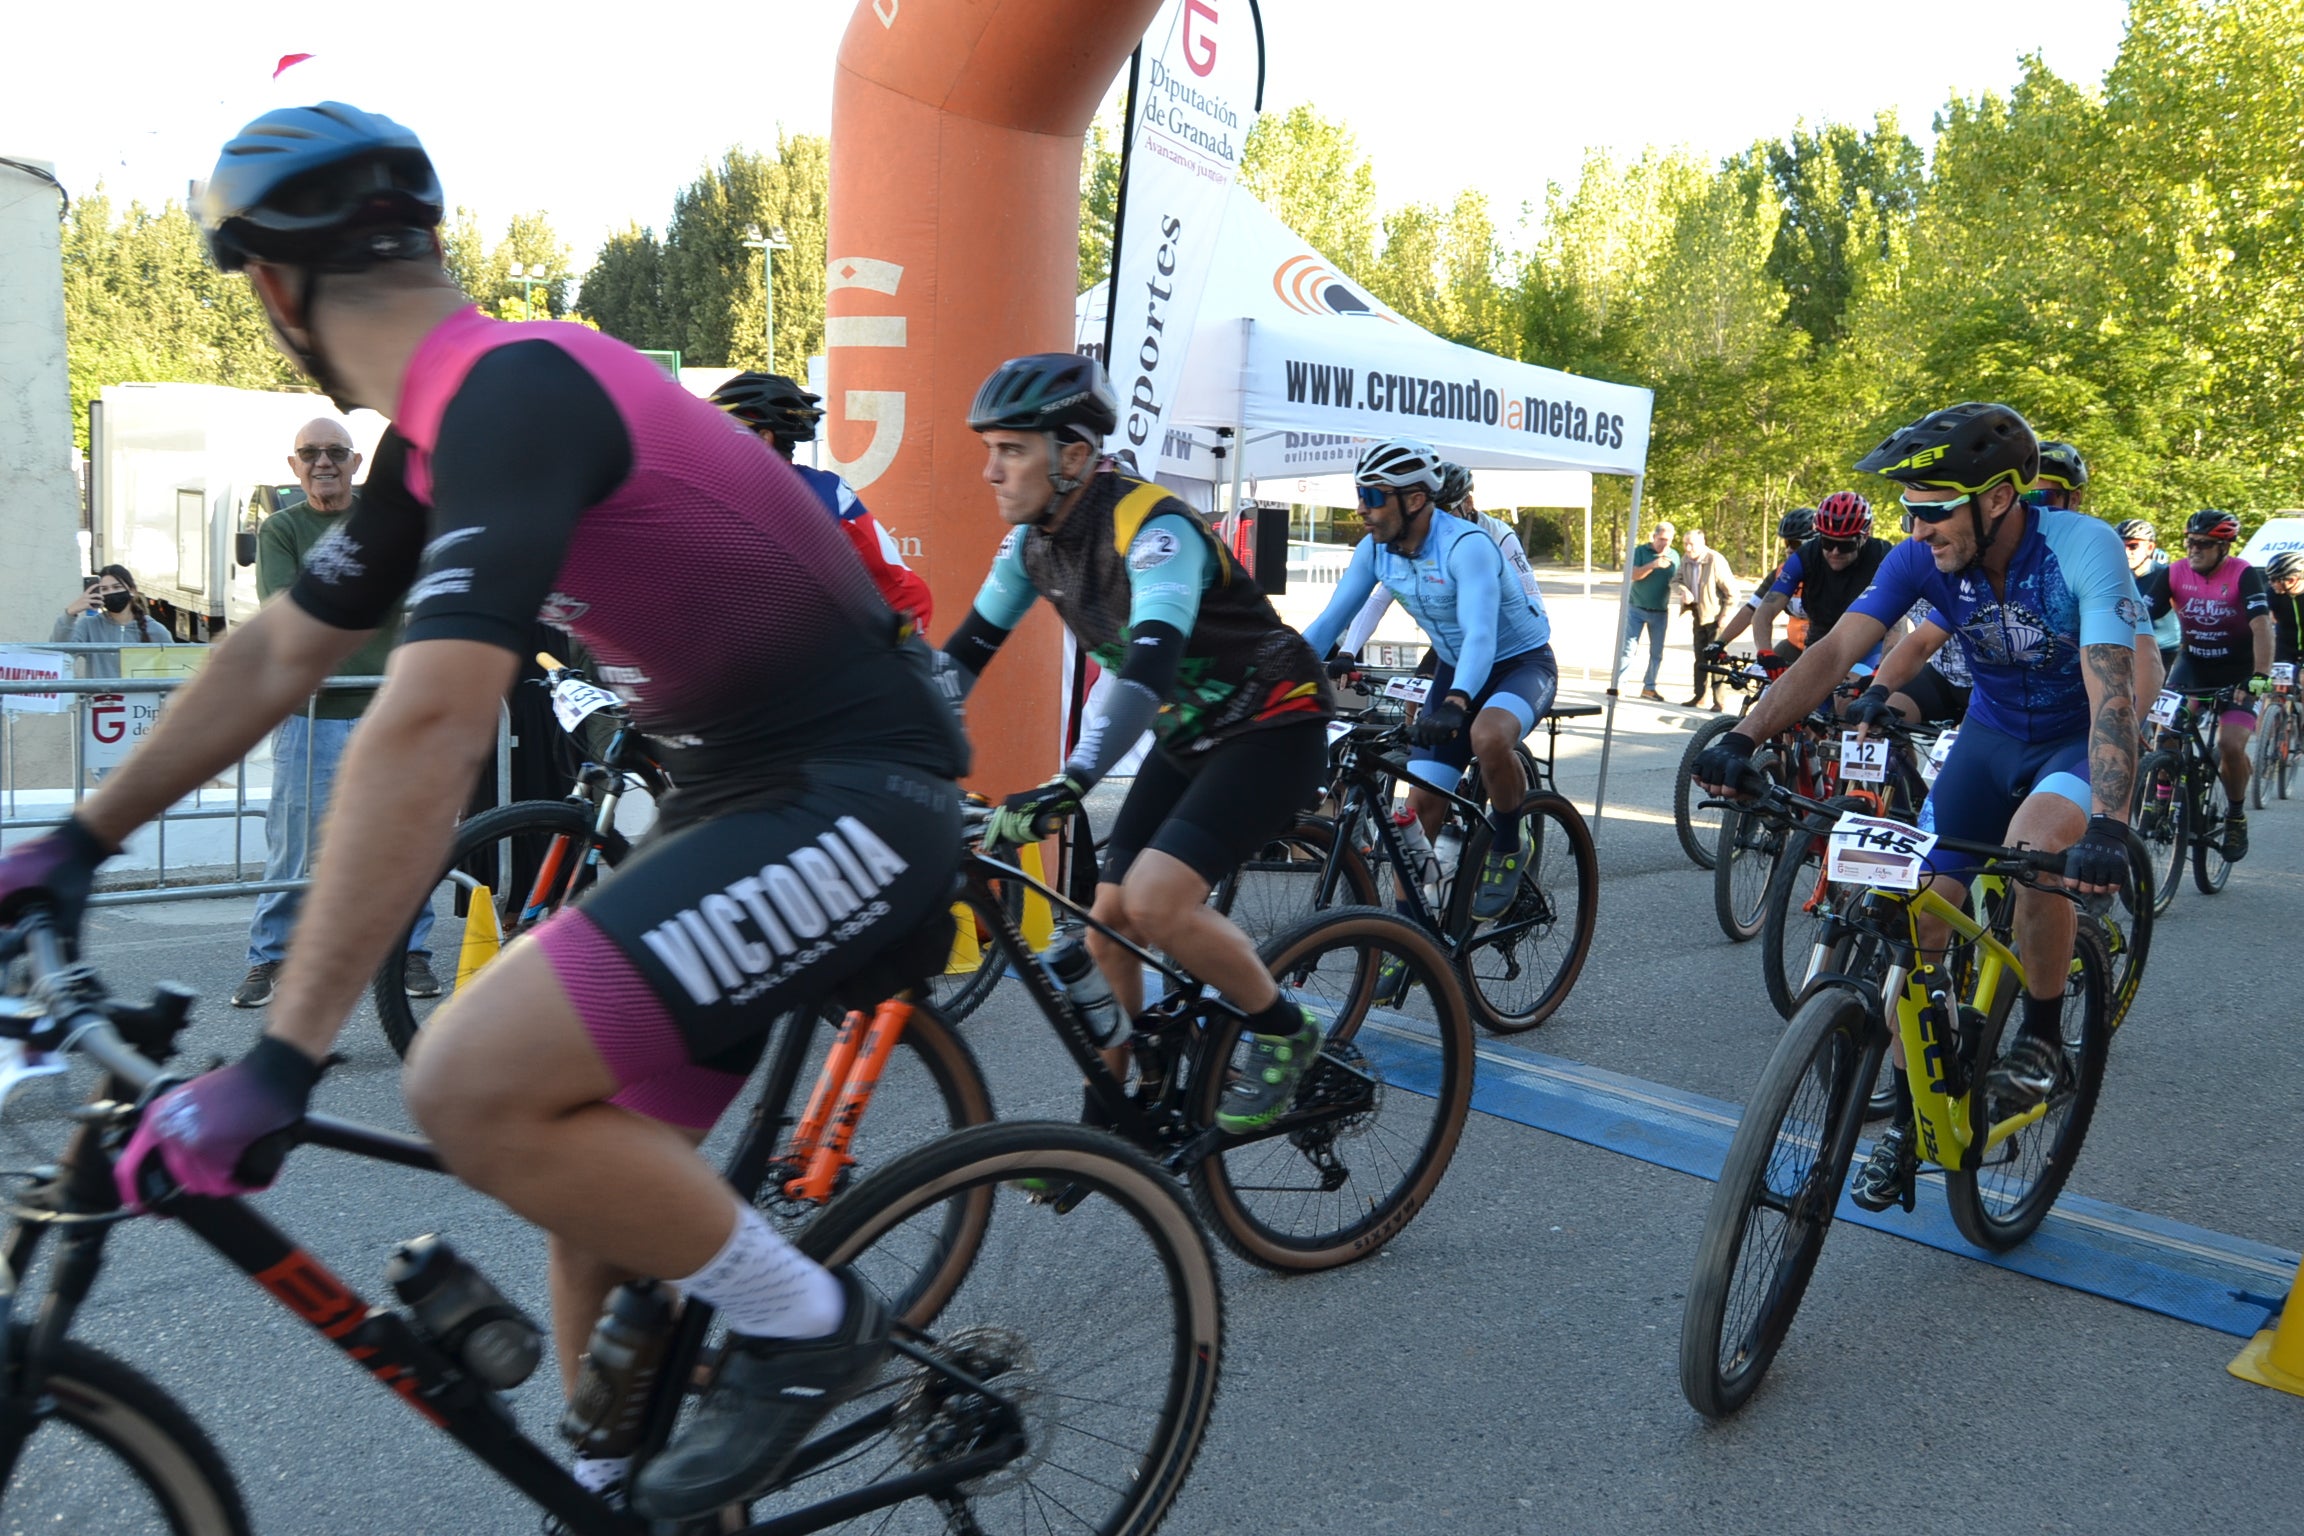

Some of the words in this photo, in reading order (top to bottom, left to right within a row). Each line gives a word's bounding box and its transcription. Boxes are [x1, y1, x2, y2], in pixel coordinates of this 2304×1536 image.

[1150, 57, 1238, 129] Diputación
[1146, 95, 1166, 127] de
[1168, 107, 1235, 162] Granada
[1144, 135, 1197, 172] Avanzamos
[1285, 359, 1625, 450] www.cruzandolameta.es
[2188, 644, 2229, 657] VICTORIA
[569, 685, 601, 708] 131
[1856, 744, 1875, 762] 12
[1856, 827, 1918, 855] 145
[640, 815, 910, 1006] VICTORIA
[1917, 1107, 1943, 1167] FELT
